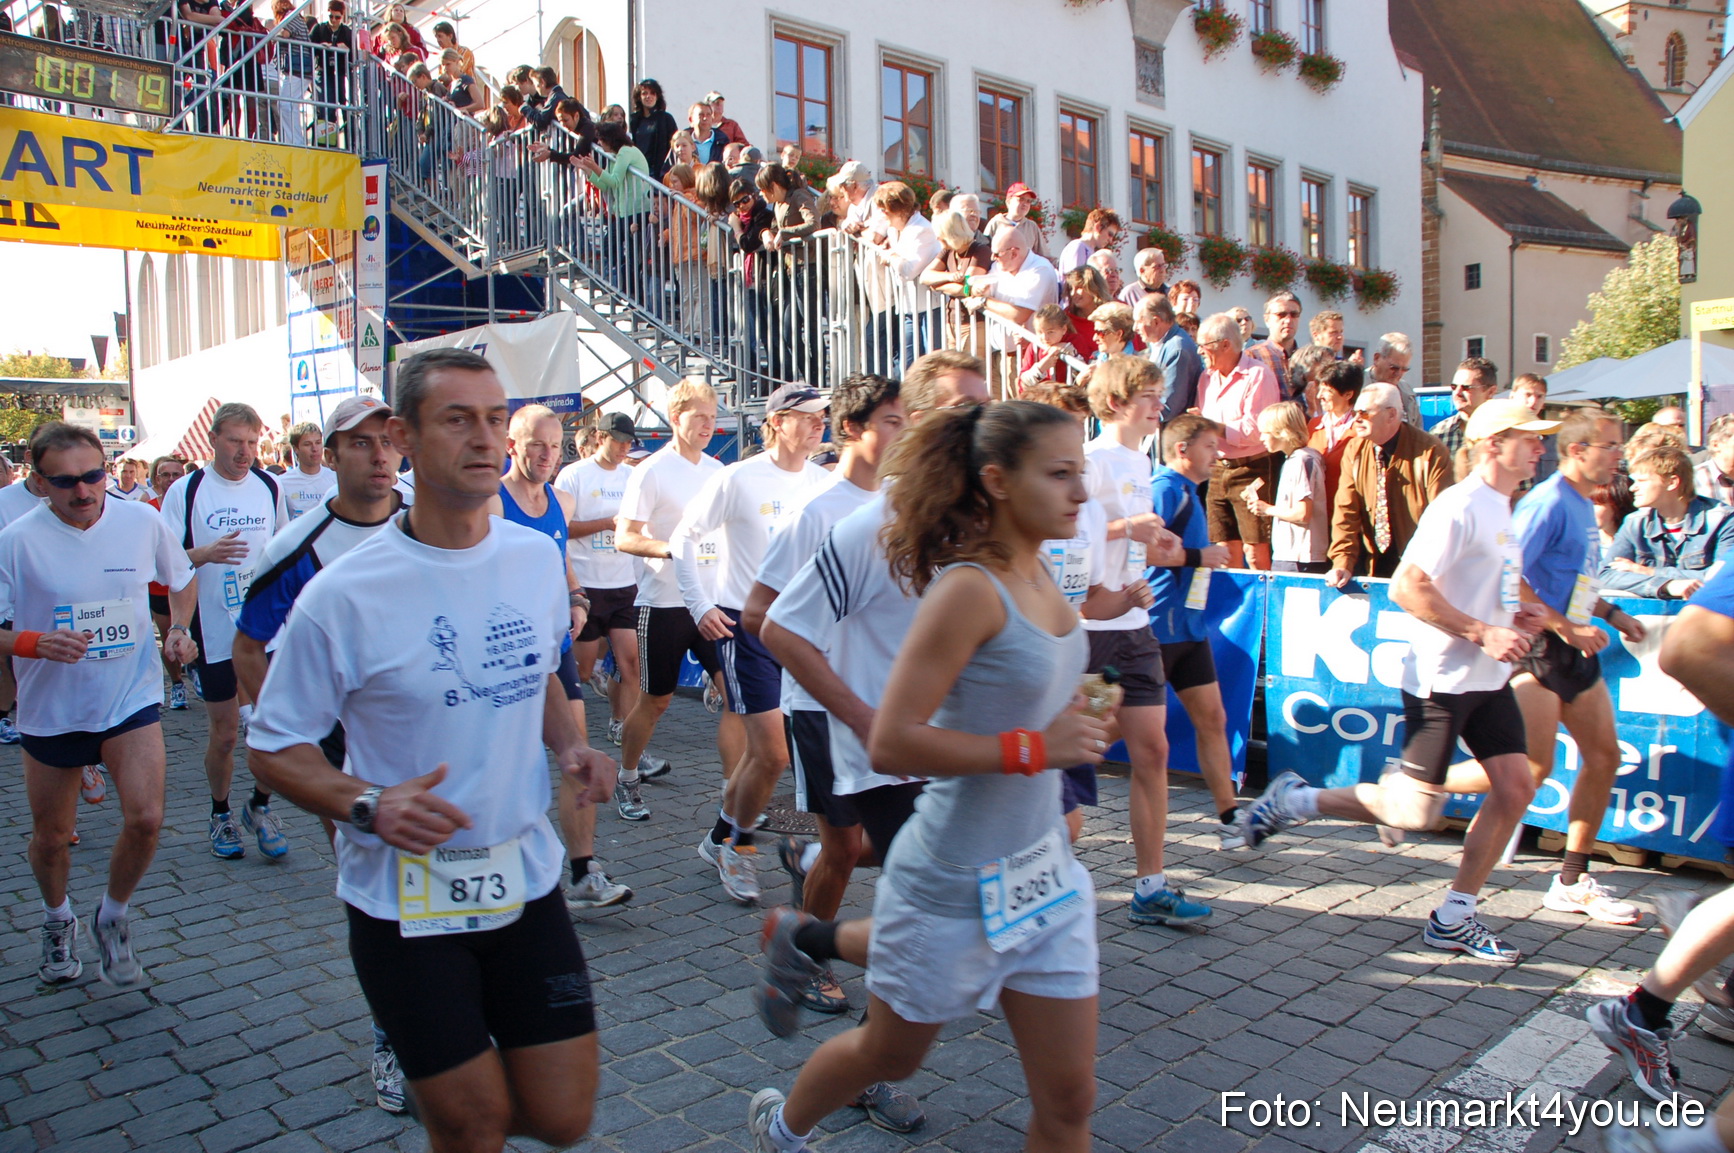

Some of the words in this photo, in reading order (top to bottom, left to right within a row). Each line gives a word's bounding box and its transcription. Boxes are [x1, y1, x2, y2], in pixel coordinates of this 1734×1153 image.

[197, 181, 272, 199] Neumarkter
[274, 189, 329, 204] Stadtlauf
[219, 515, 267, 527] Fischer
[77, 606, 106, 621] Josef
[444, 689, 468, 707] 8.
[450, 873, 507, 903] 873
